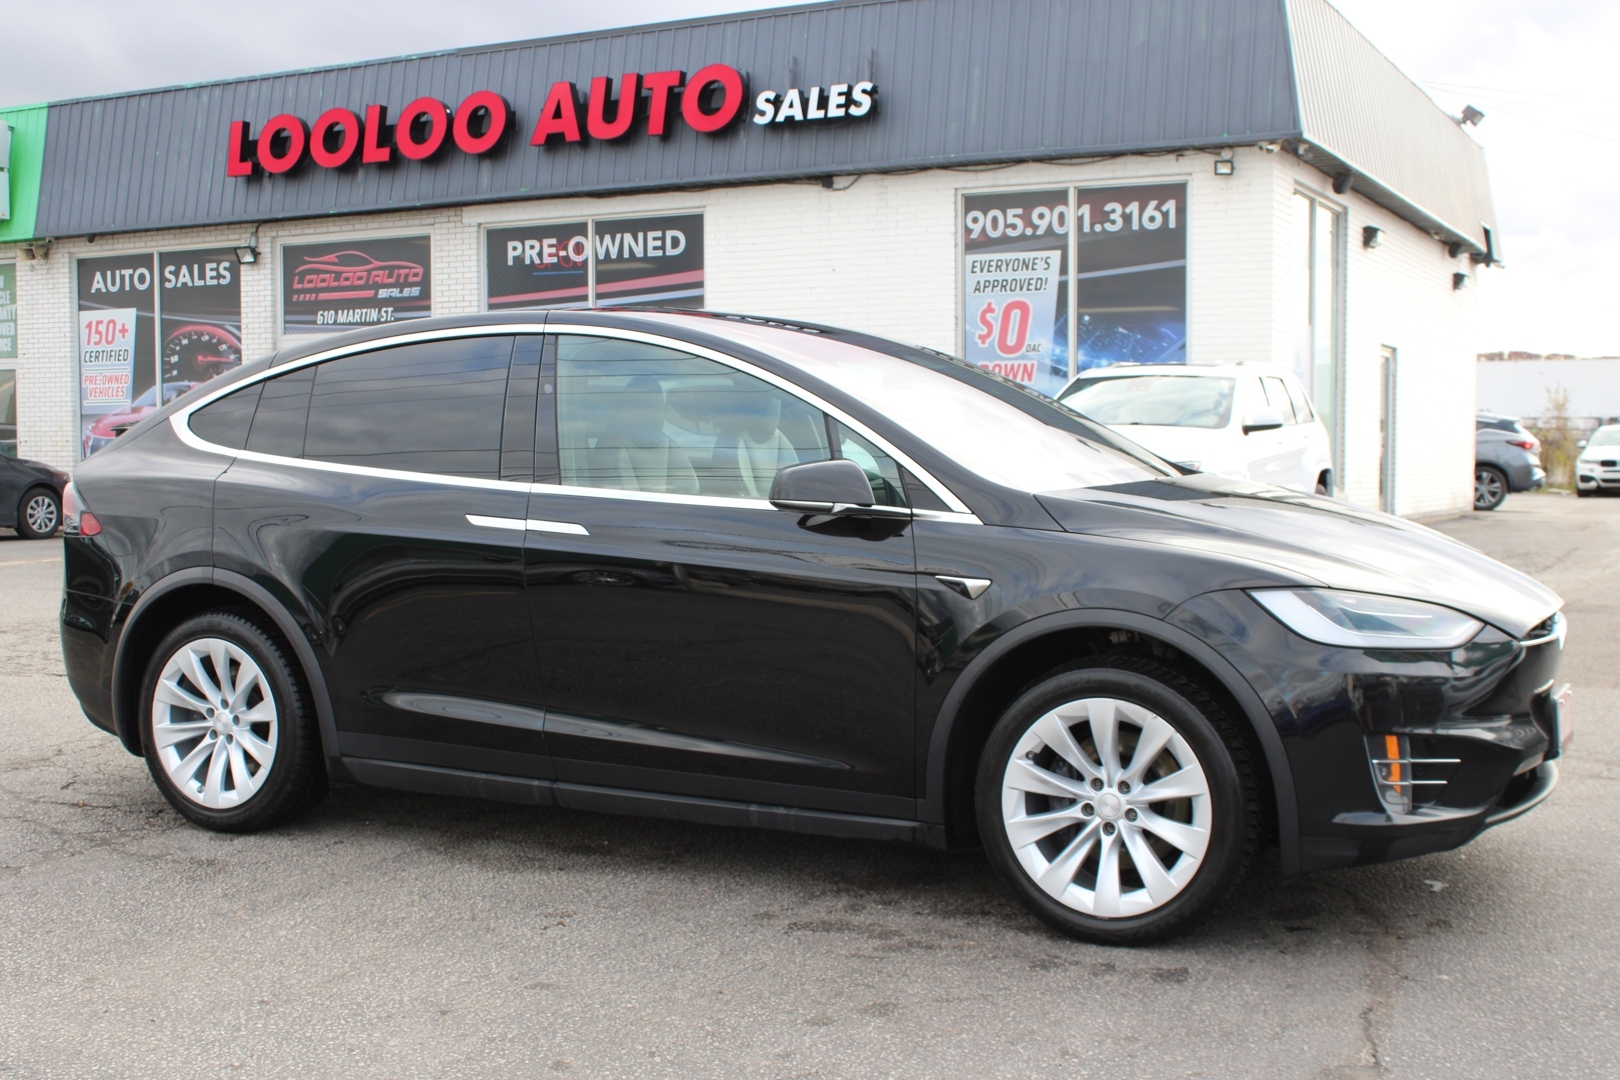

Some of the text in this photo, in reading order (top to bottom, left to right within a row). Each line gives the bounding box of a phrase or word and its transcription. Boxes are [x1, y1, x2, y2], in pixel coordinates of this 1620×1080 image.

[227, 63, 875, 178] LOOLOO AUTO SALES
[965, 199, 1176, 239] 905.901.3161
[507, 230, 687, 266] PRE-OWNED
[970, 256, 1052, 274] EVERYONE'S
[90, 261, 232, 294] AUTO SALES
[292, 268, 424, 290] LOOLOO AUTO
[973, 277, 1049, 294] APPROVED!
[377, 286, 421, 299] SALES
[317, 307, 395, 325] 610 MARTIN ST.
[85, 319, 129, 346] 150+
[975, 300, 1042, 355] $0 OAC
[84, 349, 130, 363] CERTIFIED
[84, 374, 130, 386] PRE-OWNED
[89, 386, 125, 398] VEHICLES
